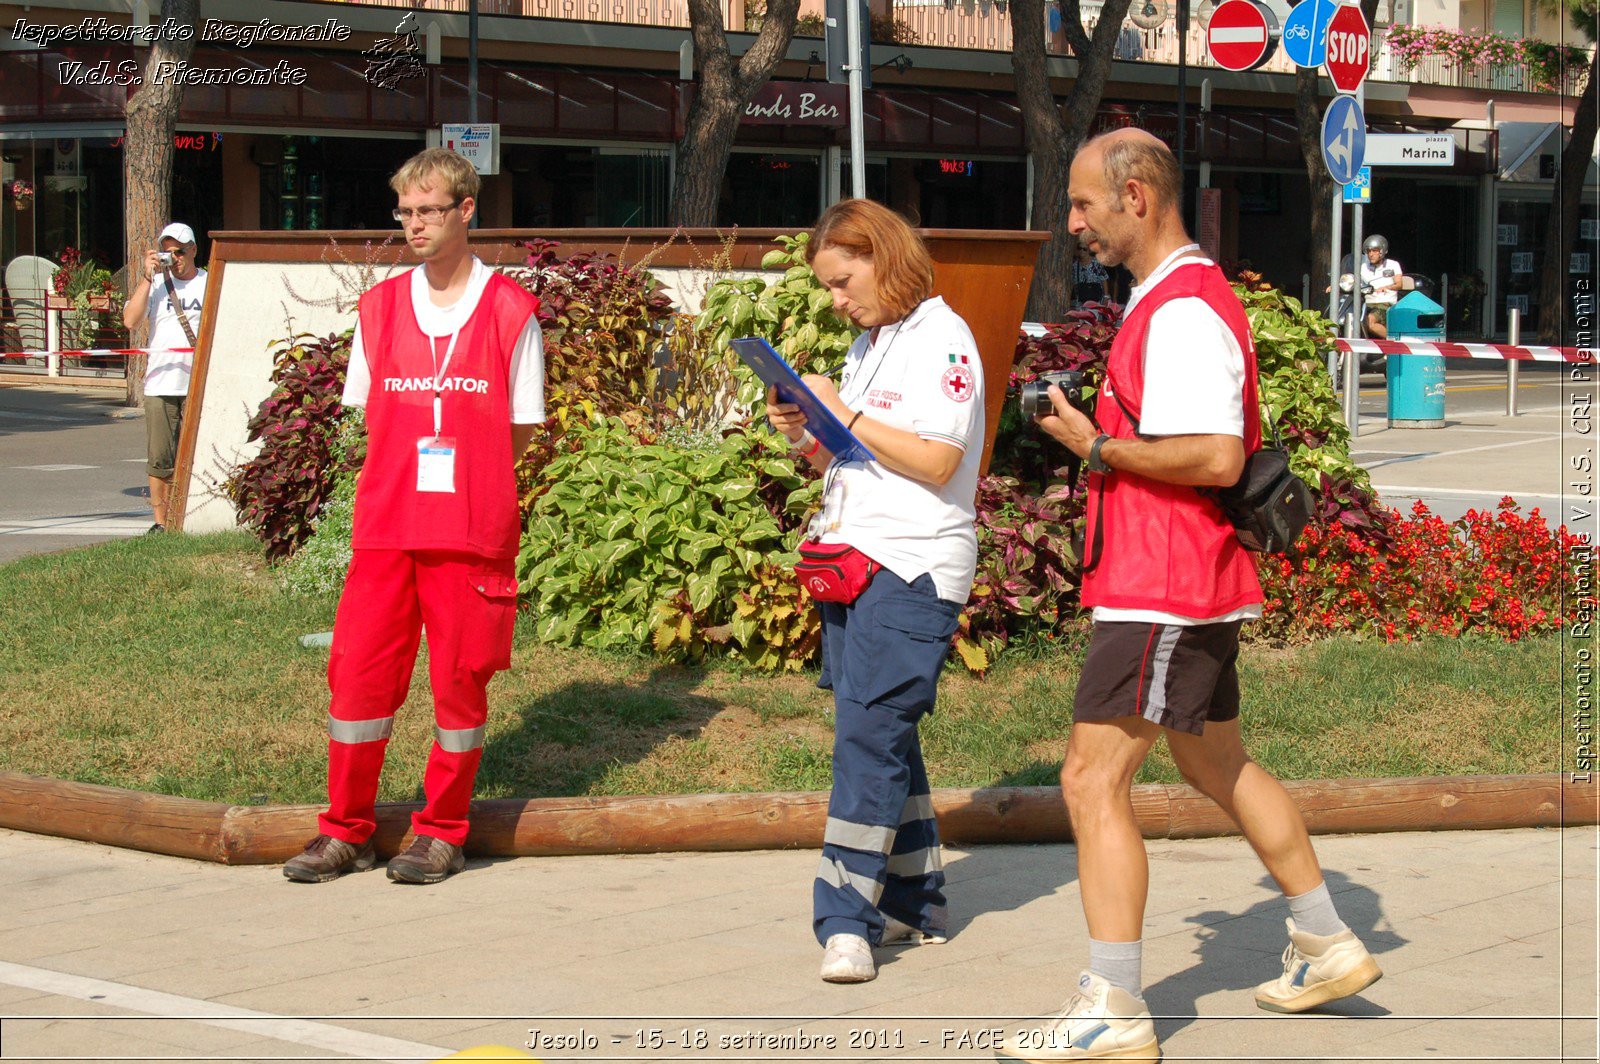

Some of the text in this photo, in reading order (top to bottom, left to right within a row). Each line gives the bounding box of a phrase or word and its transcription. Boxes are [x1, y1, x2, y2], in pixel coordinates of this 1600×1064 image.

[1328, 30, 1368, 65] STOP
[798, 92, 839, 118] Bar
[1402, 147, 1447, 159] Marina
[166, 298, 202, 311] FLA
[383, 376, 489, 394] TRANSLATOR
